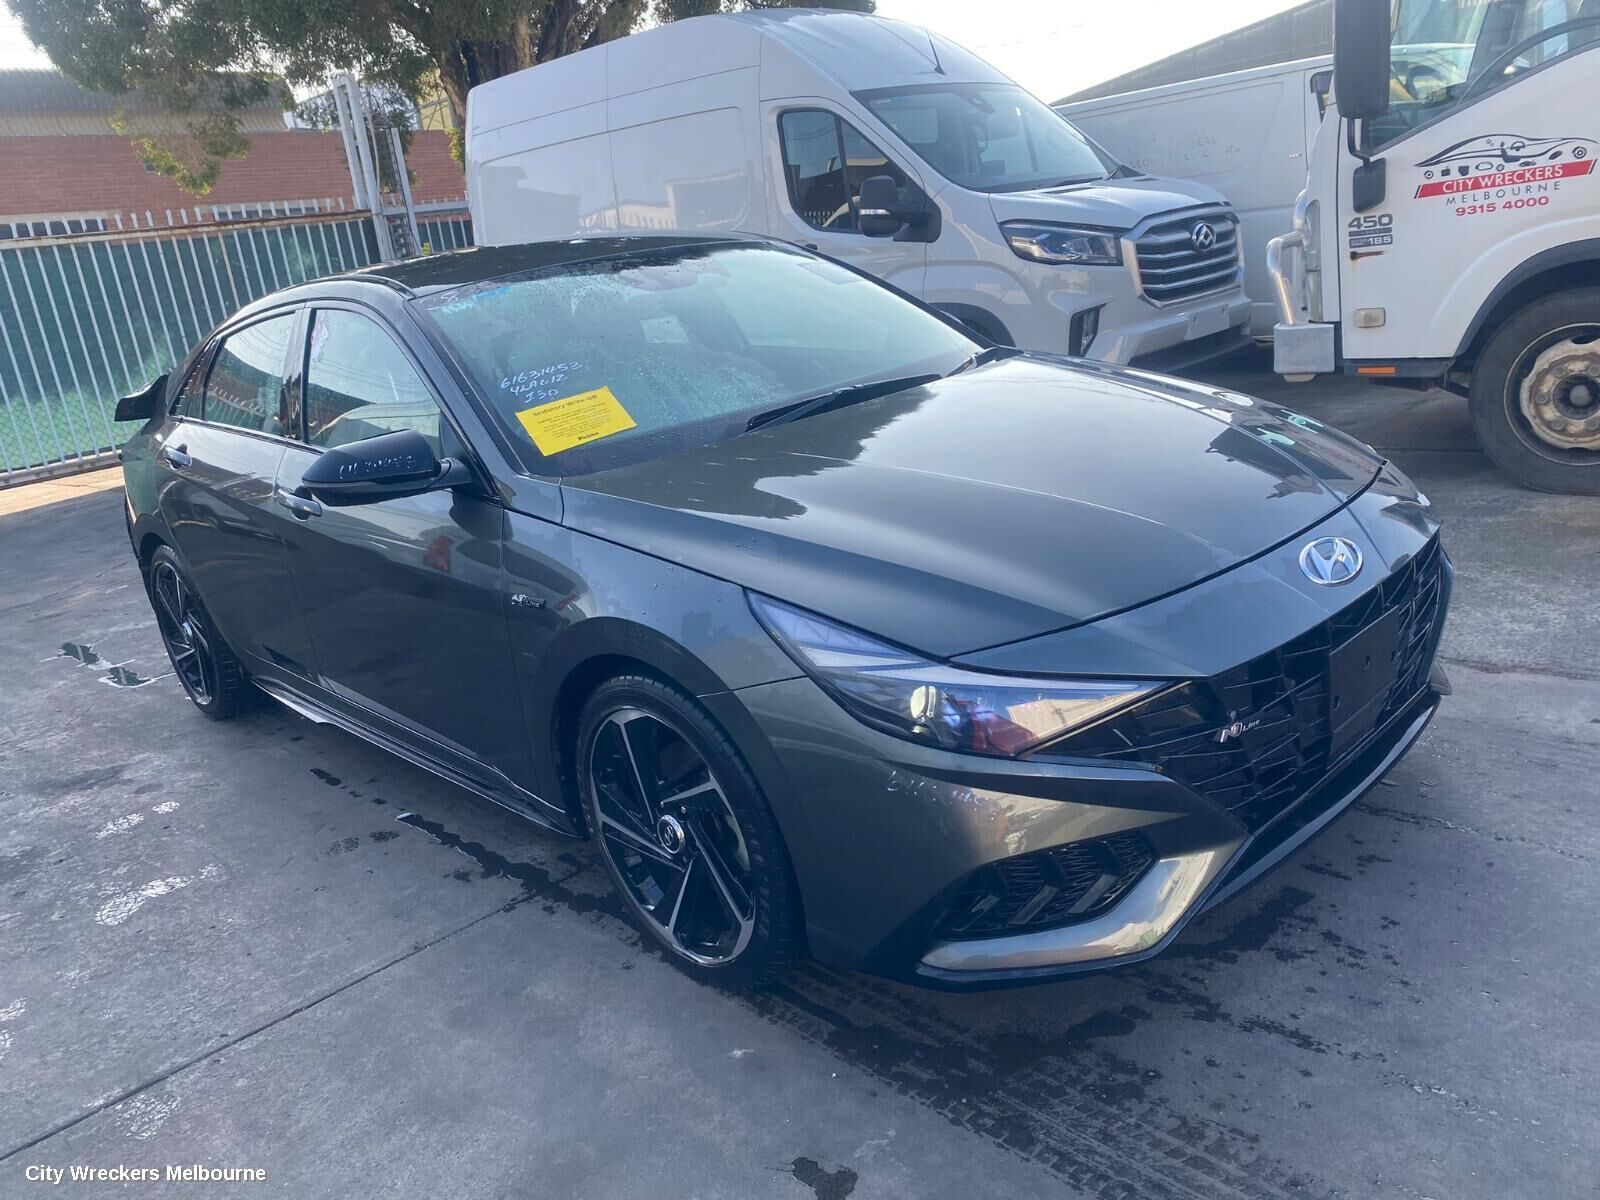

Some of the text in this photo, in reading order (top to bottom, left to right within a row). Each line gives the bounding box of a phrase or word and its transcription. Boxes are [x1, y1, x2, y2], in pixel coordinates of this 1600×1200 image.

[1442, 164, 1563, 193] CITY WRECKERS
[1446, 181, 1561, 205] MELBOURNE
[1455, 196, 1550, 216] 9315 4000
[1348, 213, 1393, 230] 450
[1368, 235, 1392, 246] 185
